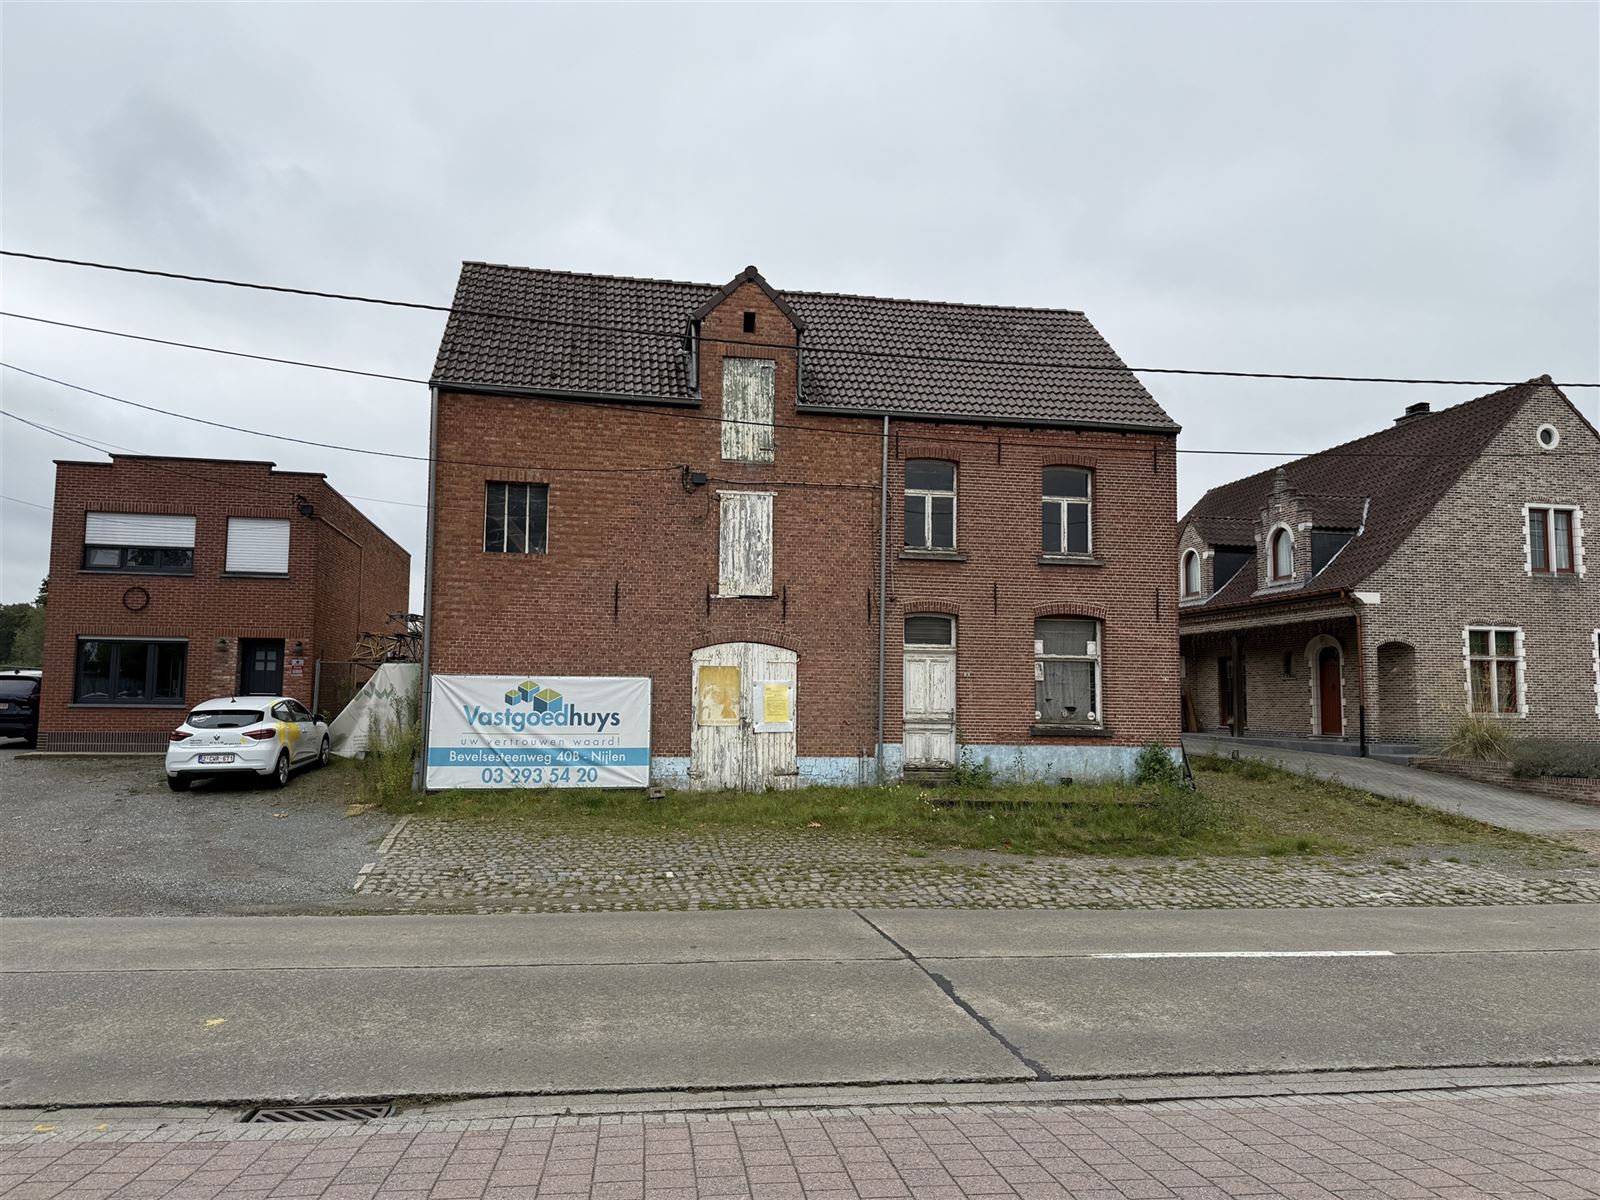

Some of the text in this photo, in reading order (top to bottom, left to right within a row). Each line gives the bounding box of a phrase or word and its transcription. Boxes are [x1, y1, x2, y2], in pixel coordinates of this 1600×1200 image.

[463, 703, 620, 732] Vastgoedhuys
[461, 736, 621, 746] uw vertrouwen waard!
[449, 750, 552, 765] Bevelsesteenweg
[556, 751, 580, 762] 40B
[591, 750, 626, 764] Nijlen
[482, 768, 598, 784] 03 293 54 20
